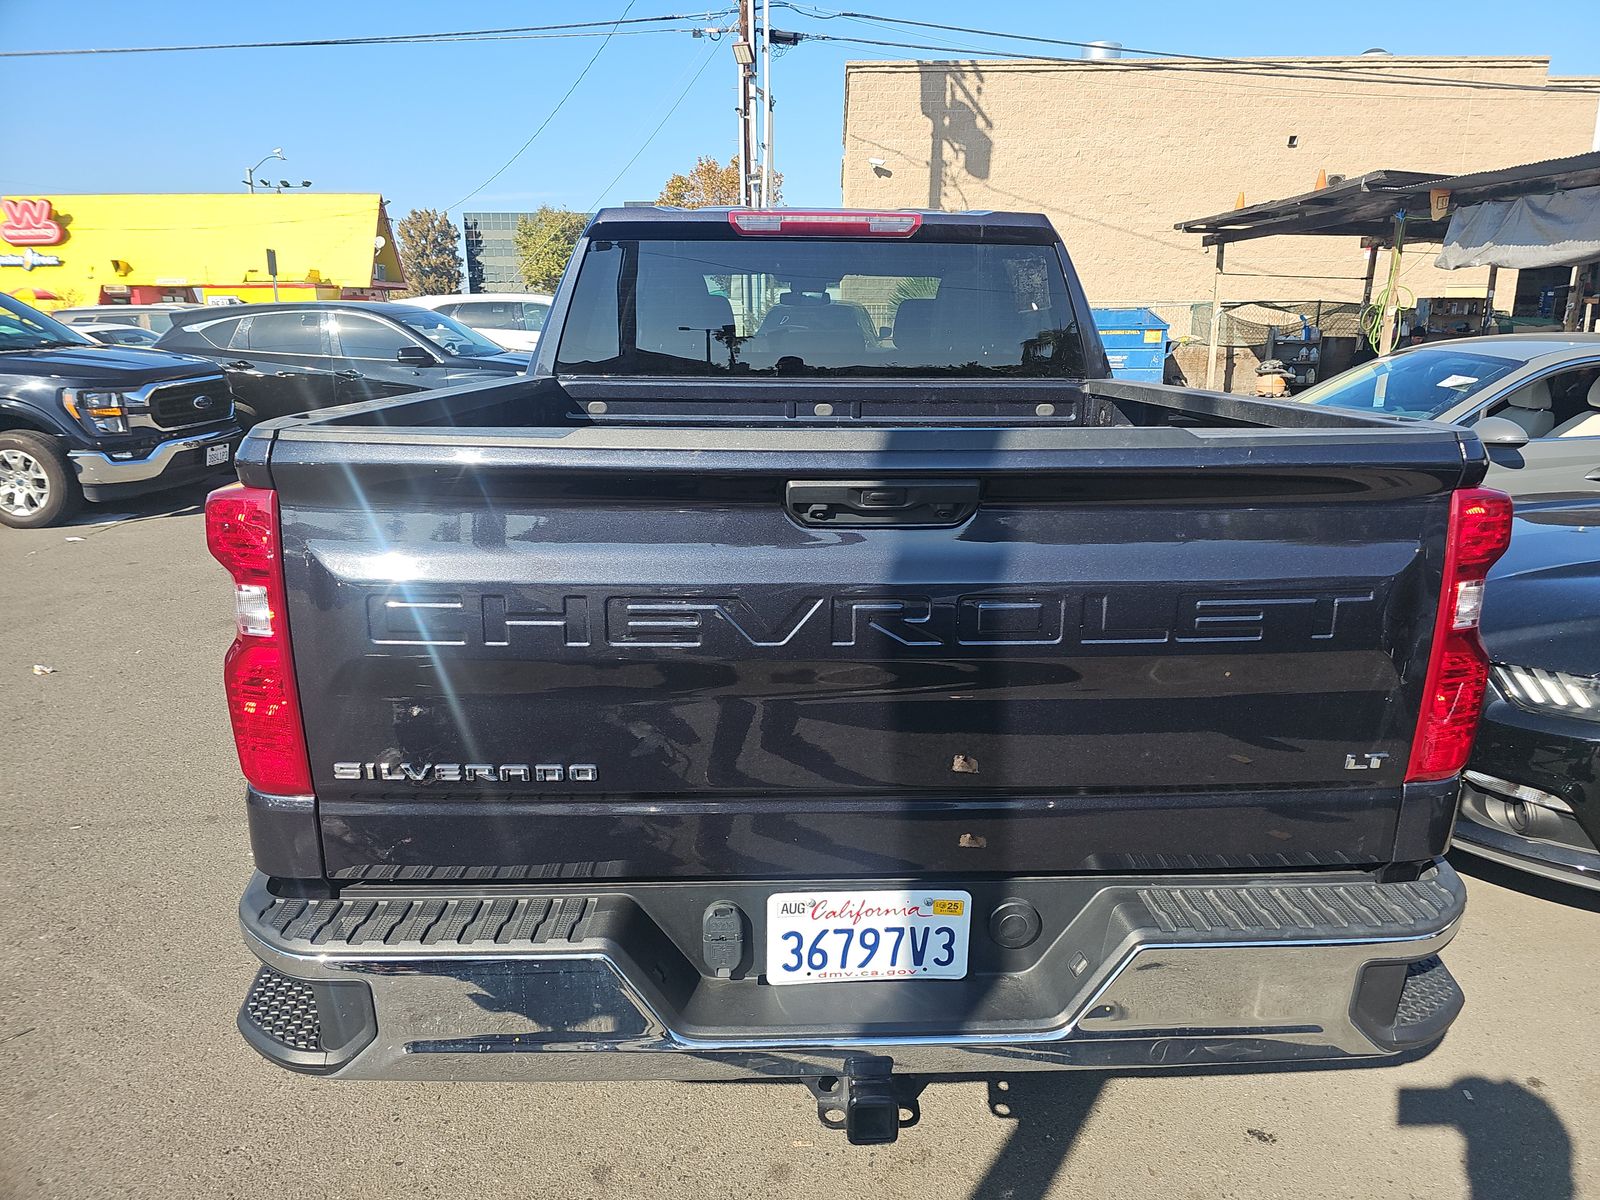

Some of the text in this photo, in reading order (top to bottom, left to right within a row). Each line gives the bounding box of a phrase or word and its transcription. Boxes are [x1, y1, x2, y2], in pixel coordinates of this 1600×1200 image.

[365, 587, 1374, 648] CHEVROLET
[1344, 751, 1389, 770] LT
[333, 762, 599, 783] SILVERADO
[781, 899, 959, 925] AUG California 25
[781, 926, 956, 972] 36797V3
[818, 968, 918, 979] dmv.ca.gov
